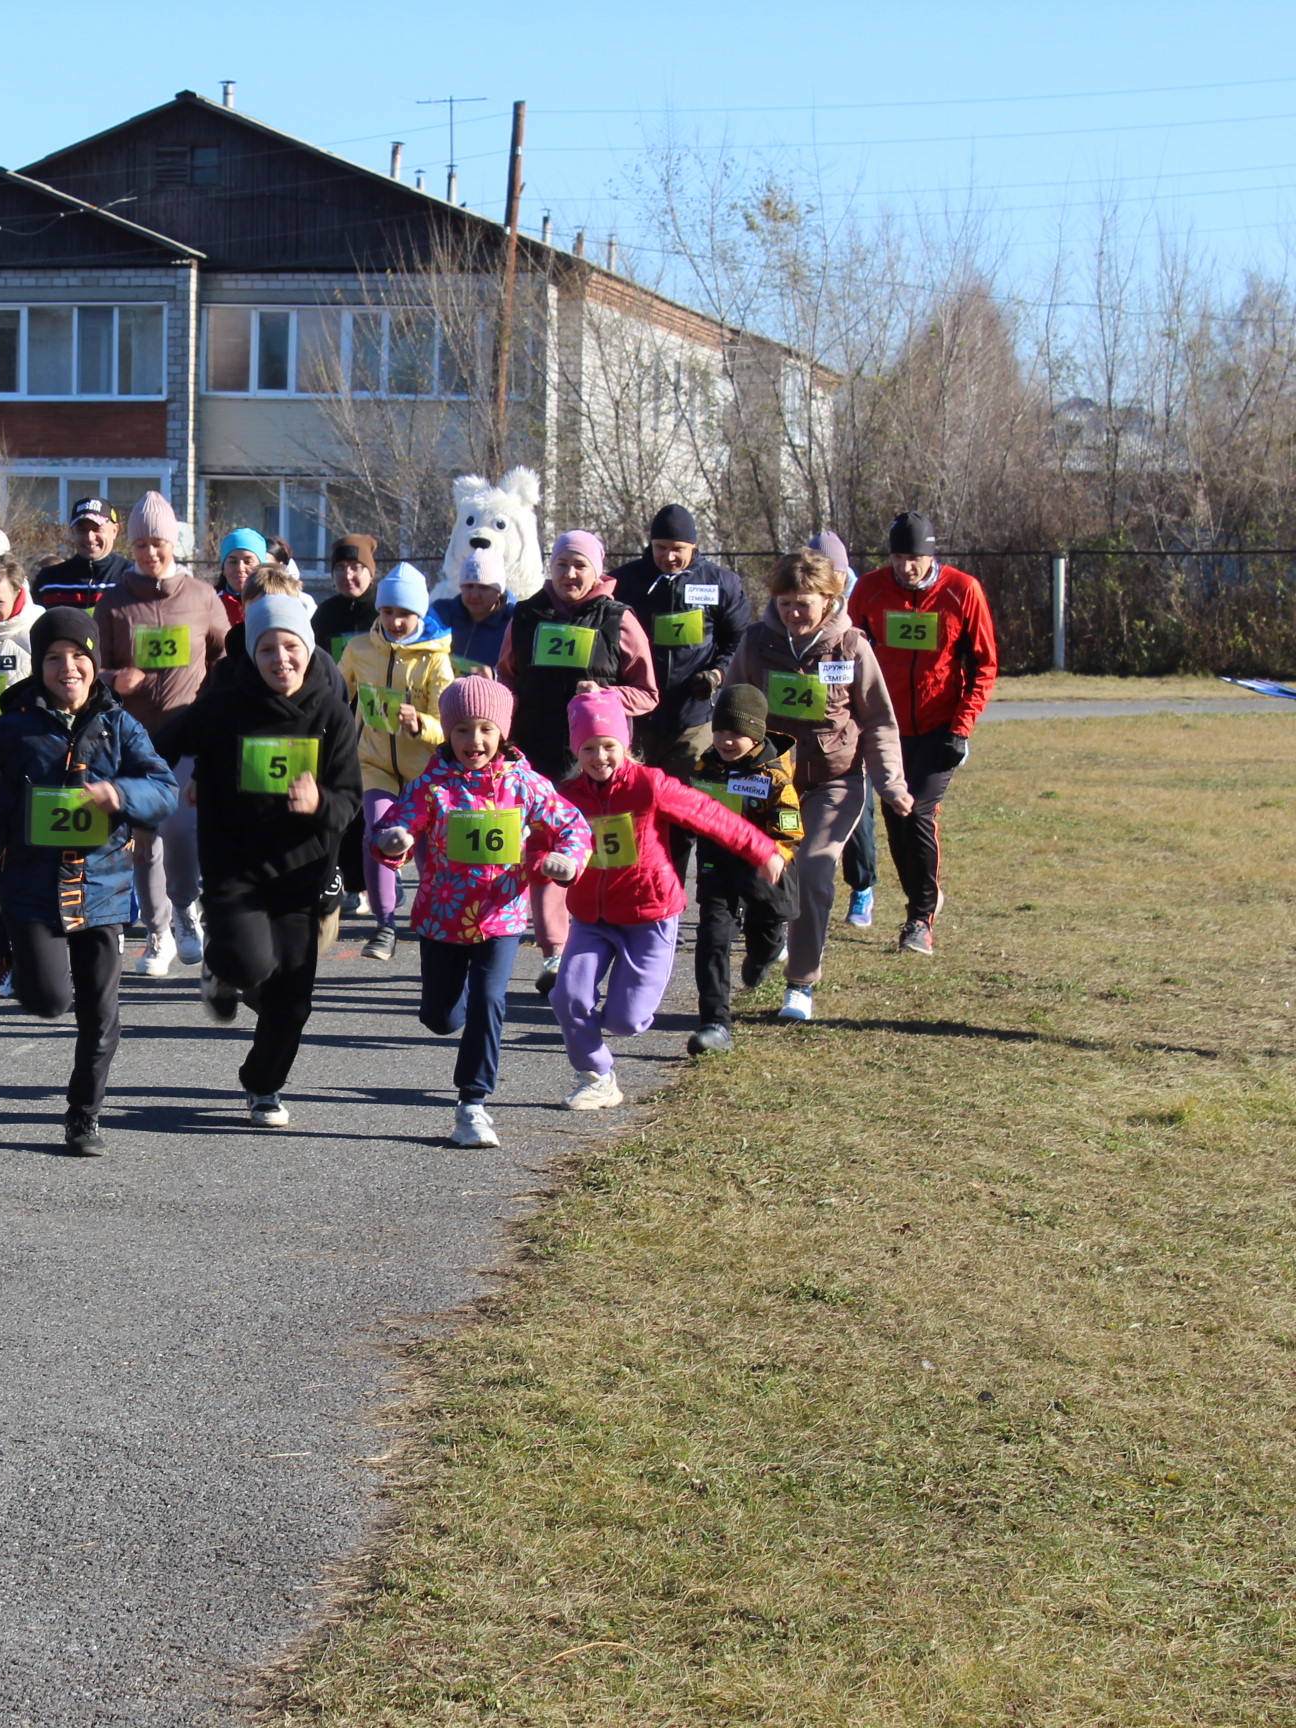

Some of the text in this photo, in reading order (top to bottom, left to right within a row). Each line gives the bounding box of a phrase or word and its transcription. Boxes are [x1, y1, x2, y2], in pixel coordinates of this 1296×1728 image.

[672, 622, 685, 638] 7
[899, 623, 927, 641] 25
[148, 639, 178, 657] 33
[547, 637, 576, 657] 21
[782, 686, 814, 708] 24
[268, 756, 288, 779] 5
[732, 784, 766, 796] СЕМЕЙКА
[50, 807, 92, 833] 20
[465, 828, 505, 852] 16
